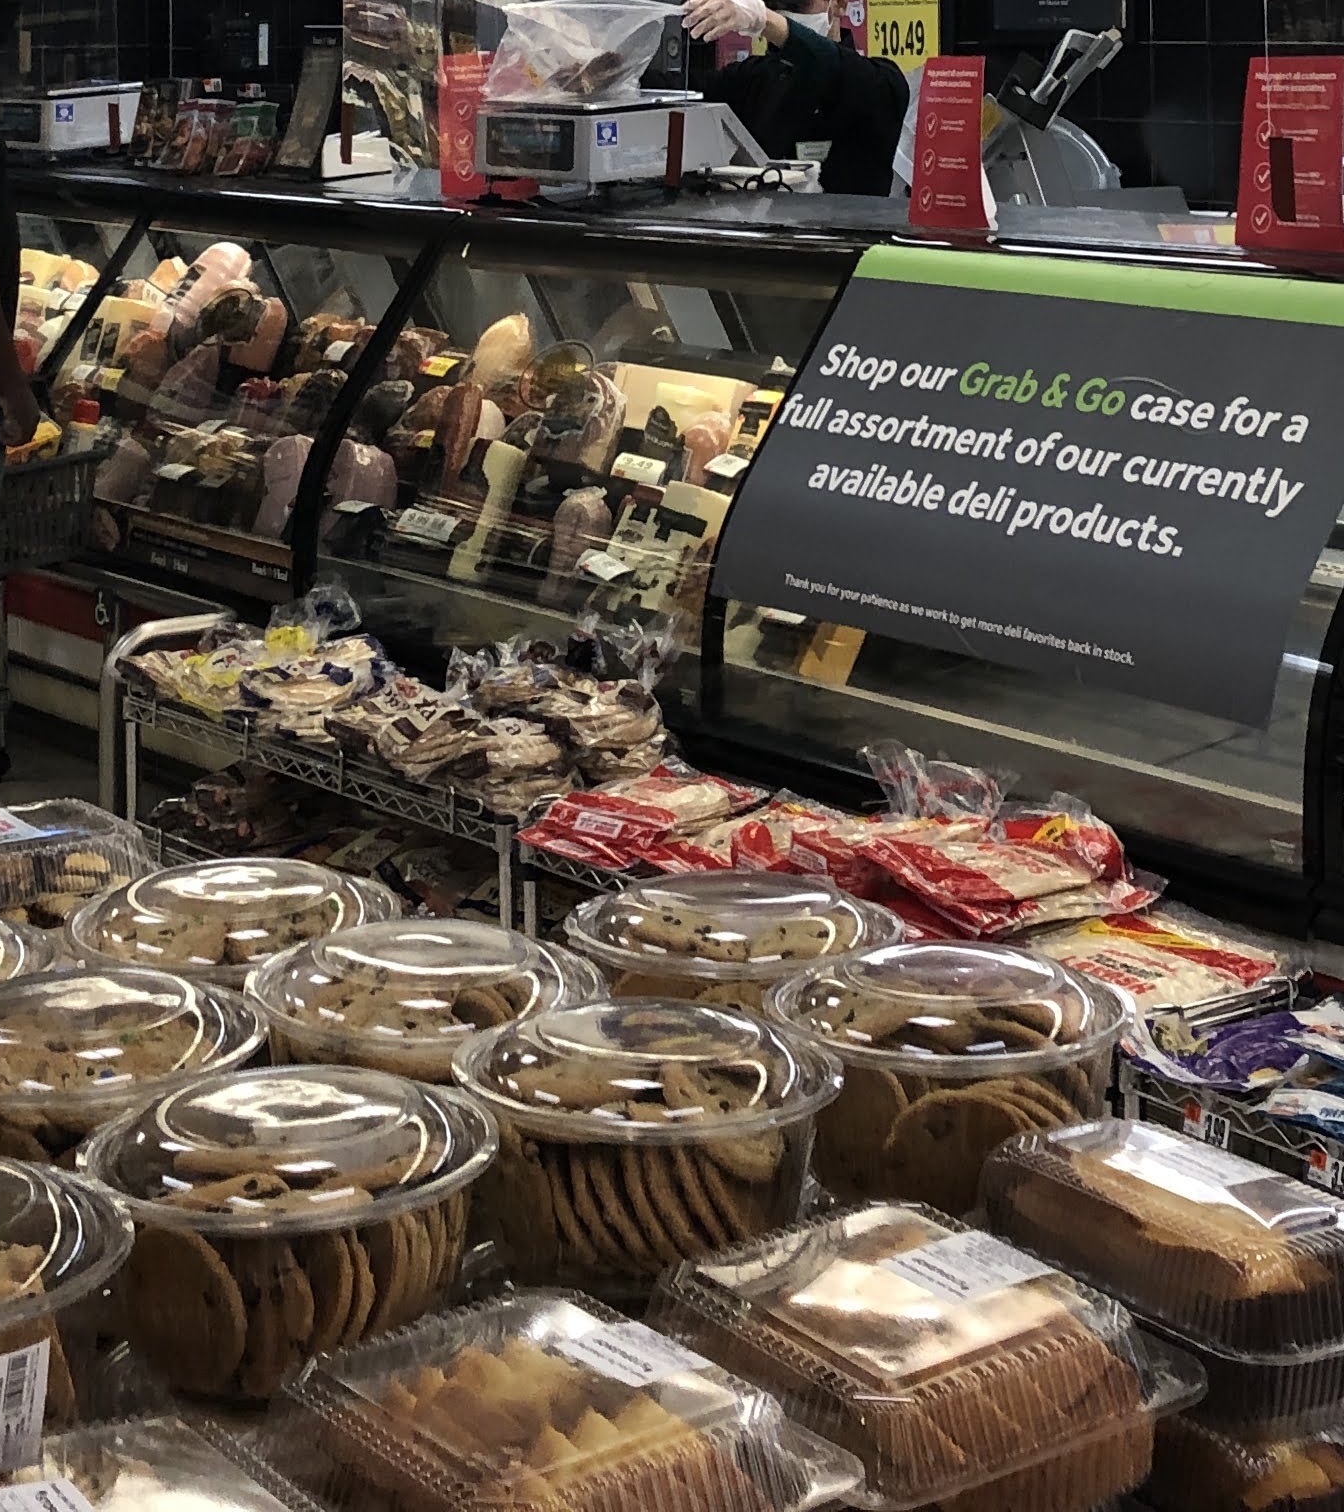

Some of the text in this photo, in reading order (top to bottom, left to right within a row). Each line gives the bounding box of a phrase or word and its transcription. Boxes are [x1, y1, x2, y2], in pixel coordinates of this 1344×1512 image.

[874, 19, 926, 57] $10.49
[819, 343, 1311, 444] Shop our Grab & Go case for a
[778, 391, 1304, 521] full assortment of our currently
[807, 458, 1185, 559] available deli products.
[785, 573, 809, 590] Thank
[809, 581, 826, 594] you
[826, 582, 840, 597] for
[839, 586, 861, 601] your
[860, 591, 898, 612] patience
[898, 602, 909, 614] as
[911, 605, 924, 616] we
[925, 607, 948, 622] work
[949, 611, 960, 624] to
[960, 615, 977, 631] get
[977, 619, 1003, 635] more
[1003, 622, 1022, 639] deli
[1022, 627, 1067, 650] favorites
[1067, 639, 1092, 656] back
[1092, 642, 1103, 658] in
